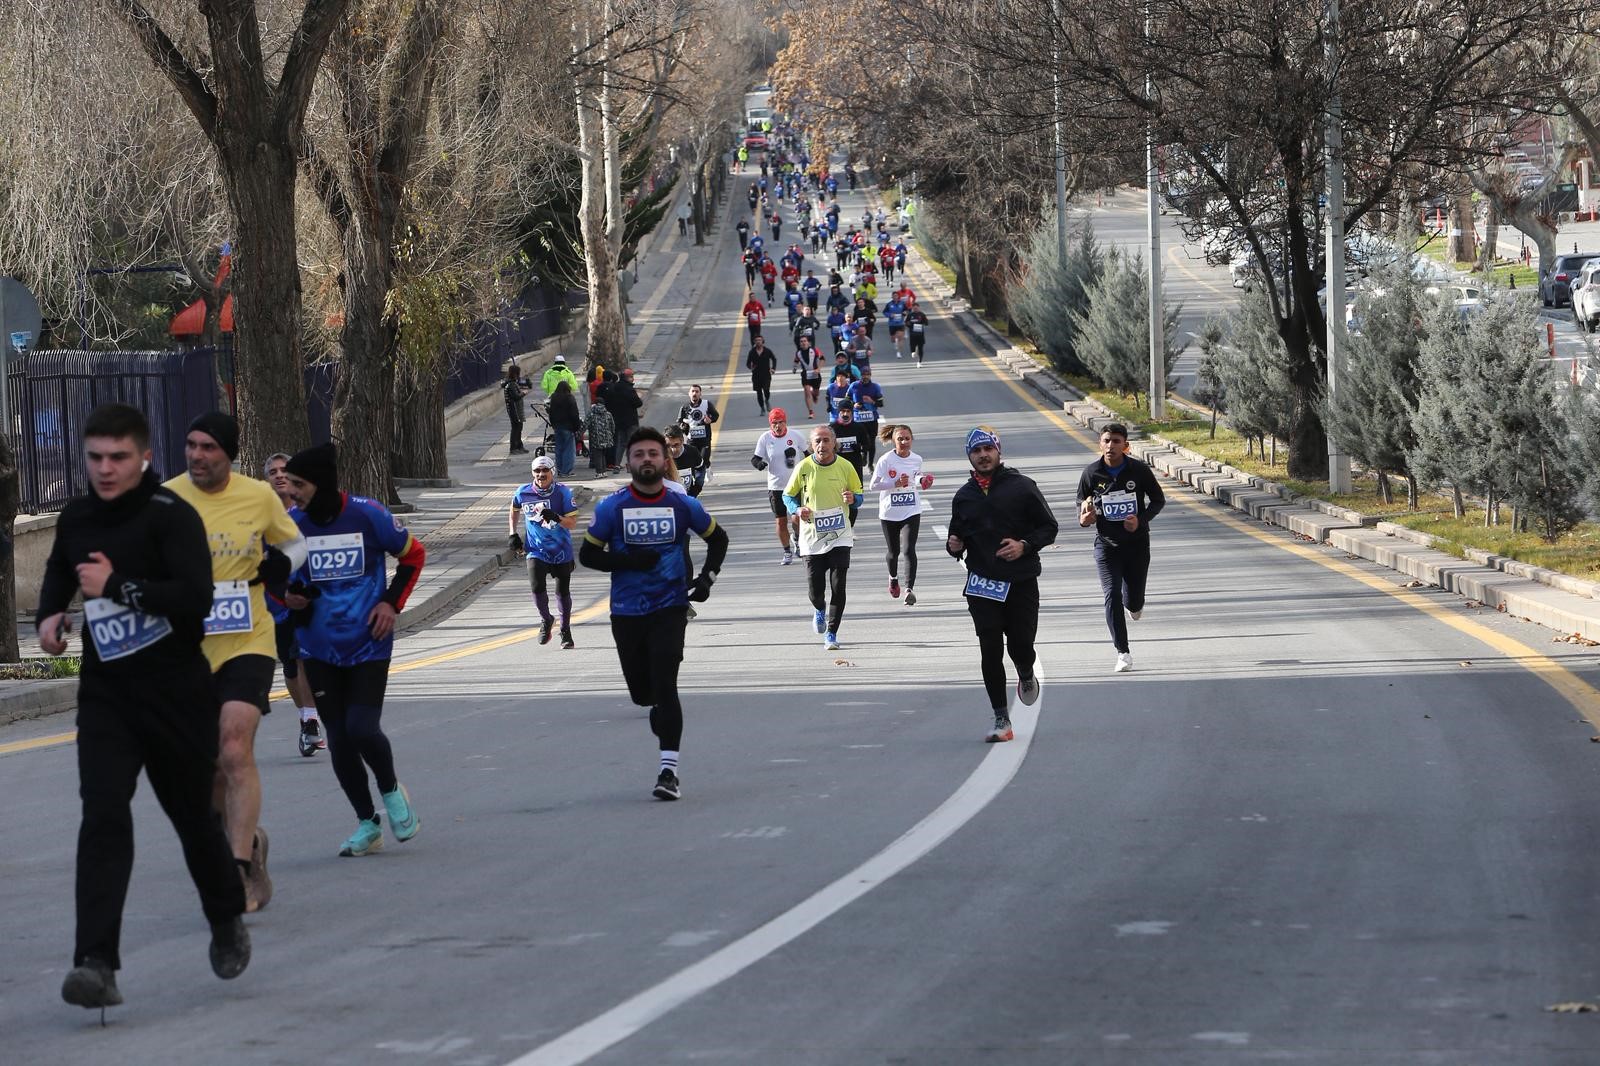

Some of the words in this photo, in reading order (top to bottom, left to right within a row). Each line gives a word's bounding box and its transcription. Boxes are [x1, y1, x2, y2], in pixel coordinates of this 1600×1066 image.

[892, 494, 914, 503] 0679
[1105, 503, 1135, 514] 0793
[627, 520, 671, 536] 0319
[816, 516, 842, 528] 0077
[311, 550, 359, 570] 0297
[970, 574, 1005, 593] 0453
